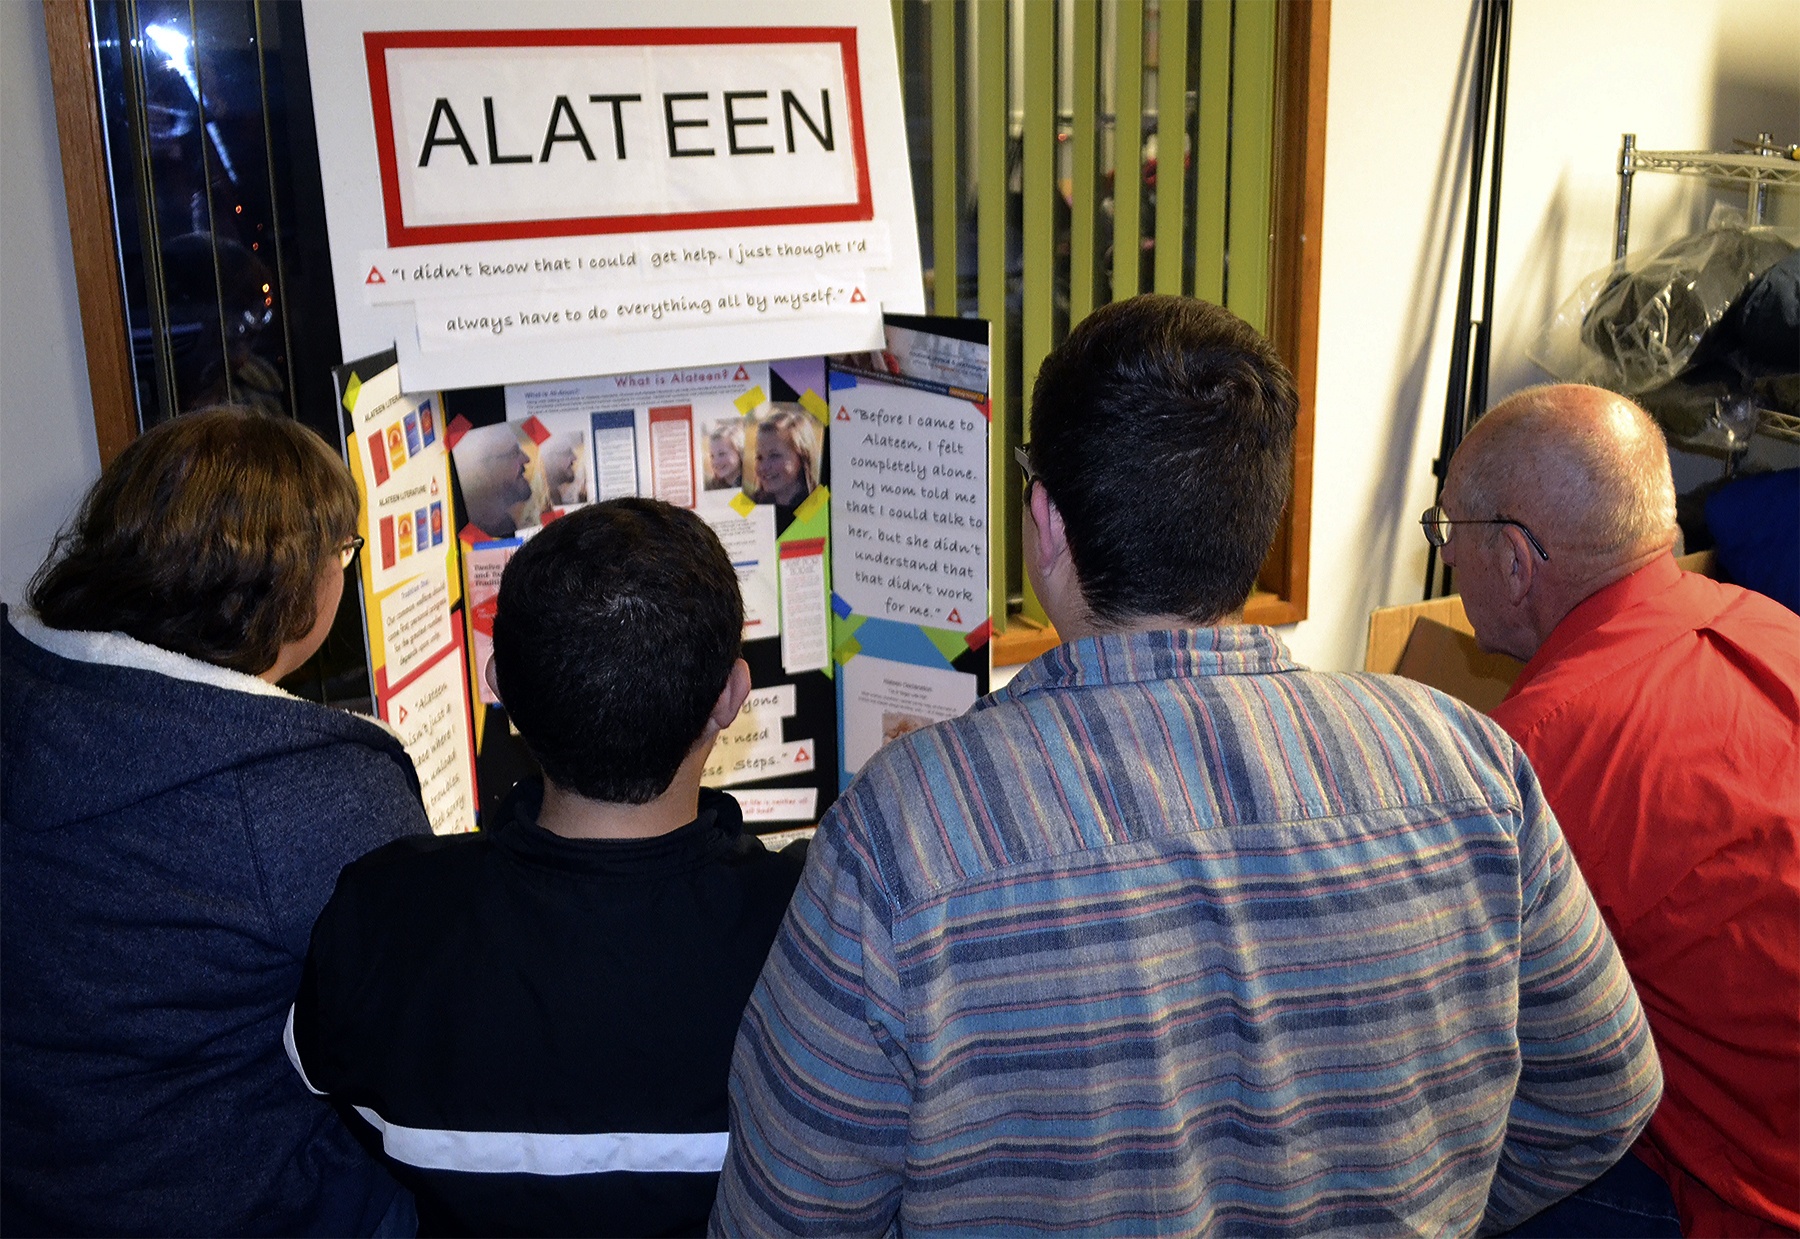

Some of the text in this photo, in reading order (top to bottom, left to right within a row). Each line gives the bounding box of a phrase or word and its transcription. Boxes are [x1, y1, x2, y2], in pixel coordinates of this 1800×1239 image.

[417, 88, 837, 168] ALATEEN
[413, 263, 472, 281] didn't
[479, 261, 529, 277] know
[534, 257, 571, 272] that
[577, 257, 582, 269] I
[589, 251, 637, 269] could
[650, 251, 678, 268] get
[682, 248, 721, 266] help.
[728, 247, 732, 259] I
[736, 243, 772, 264] just
[777, 242, 841, 259] thought
[846, 239, 867, 252] I'd
[446, 287, 844, 334] always have to do everything all by myself."
[615, 369, 728, 388] What is Alateen?
[852, 408, 974, 432] "Before I came to
[861, 433, 964, 457] Alateen, I felt
[850, 456, 977, 480] completely alone.
[851, 479, 977, 504] My mom told me
[846, 499, 983, 529] that I could talk to
[848, 524, 981, 556] her, but she didn't
[854, 551, 974, 578] understand that
[475, 579, 501, 587] Traditi
[855, 571, 974, 602] that didn't work
[885, 597, 940, 619] for me."
[742, 695, 778, 714] yone
[428, 711, 446, 736] just
[734, 727, 769, 743] need
[413, 748, 430, 768] lace
[430, 731, 451, 752] where
[430, 772, 460, 807] troubles
[445, 793, 466, 818] sorry
